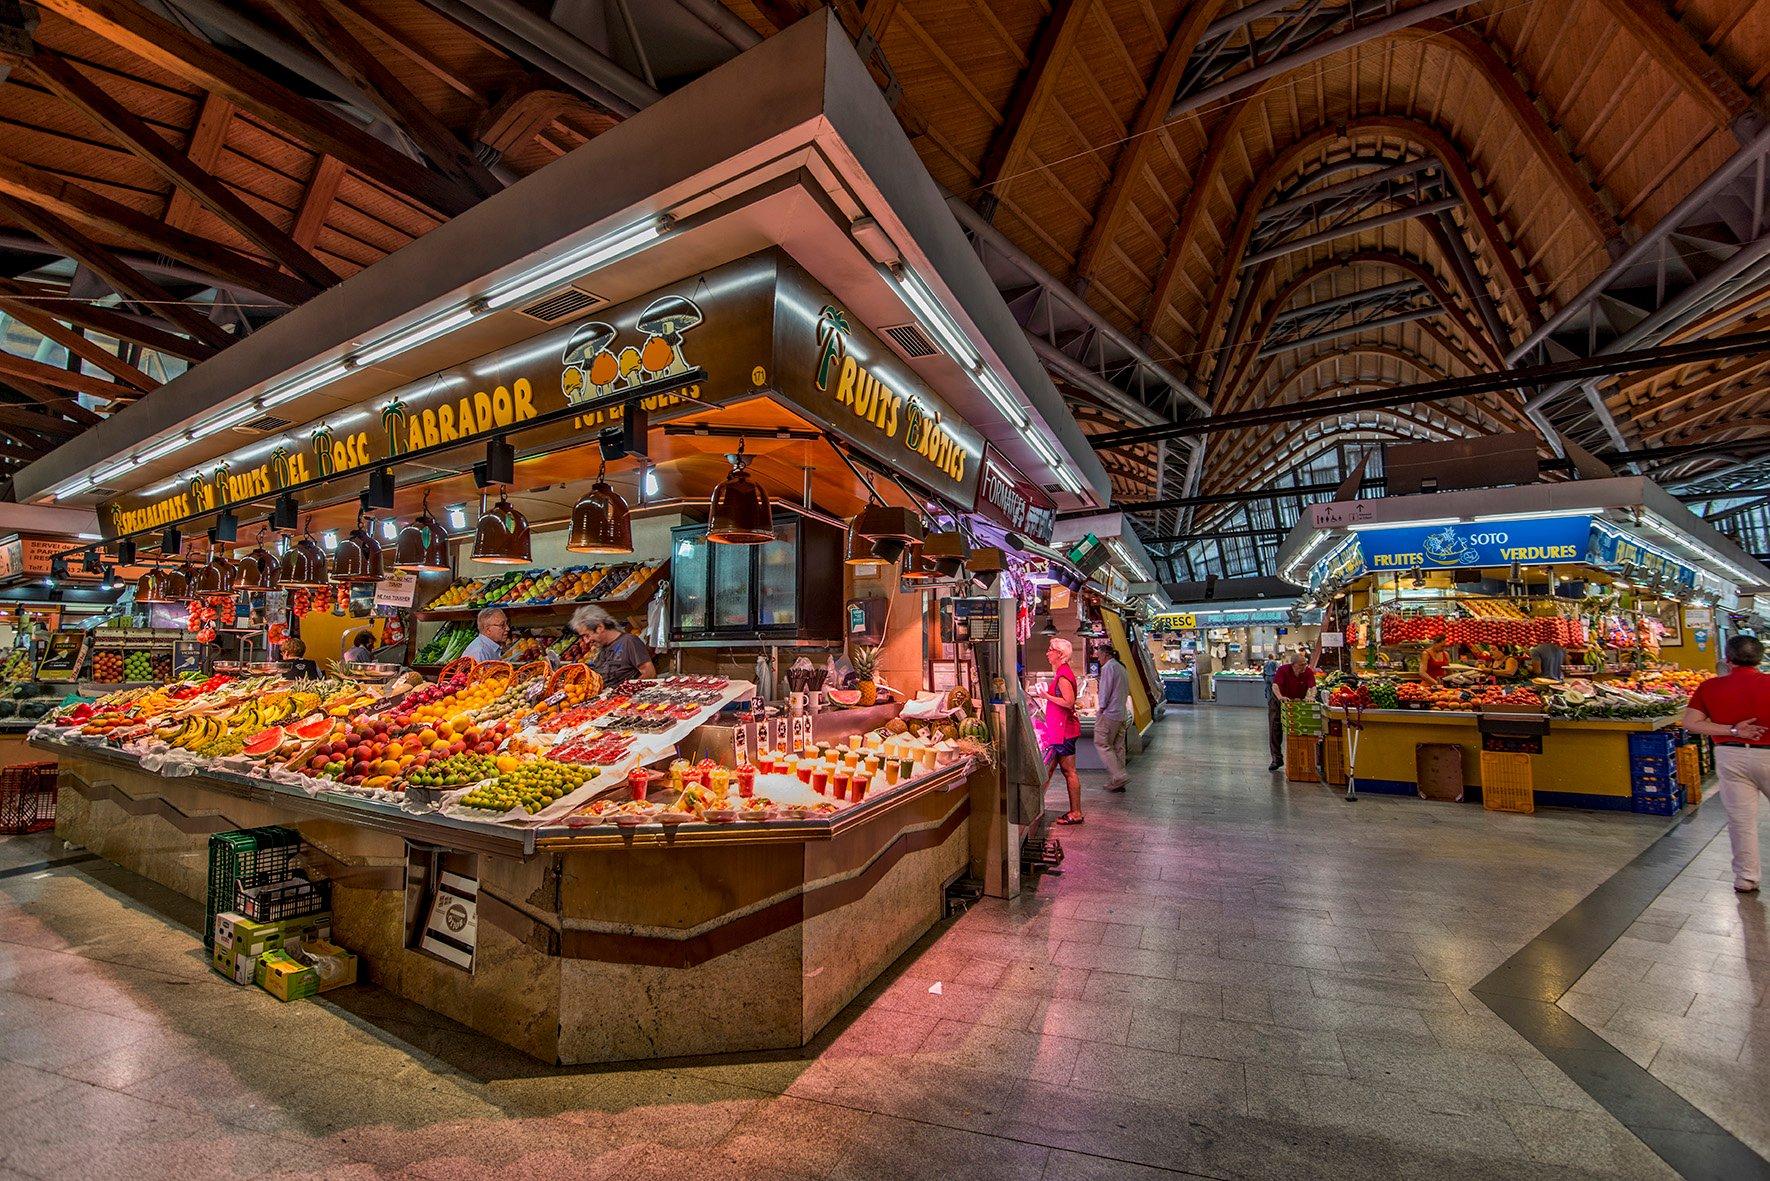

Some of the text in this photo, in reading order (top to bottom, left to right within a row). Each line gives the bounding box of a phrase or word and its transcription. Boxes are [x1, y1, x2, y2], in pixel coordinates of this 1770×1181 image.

[813, 306, 900, 438] FRUITS
[111, 492, 190, 537] ESPECIALITATS
[213, 461, 271, 505] FRUITS
[271, 448, 309, 489] DEL
[311, 426, 371, 477] BOSC
[380, 377, 538, 457] LABRADOR
[1374, 551, 1424, 567] FRUITES
[1500, 544, 1577, 562] VERDURES
[1469, 531, 1508, 546] SOTO
